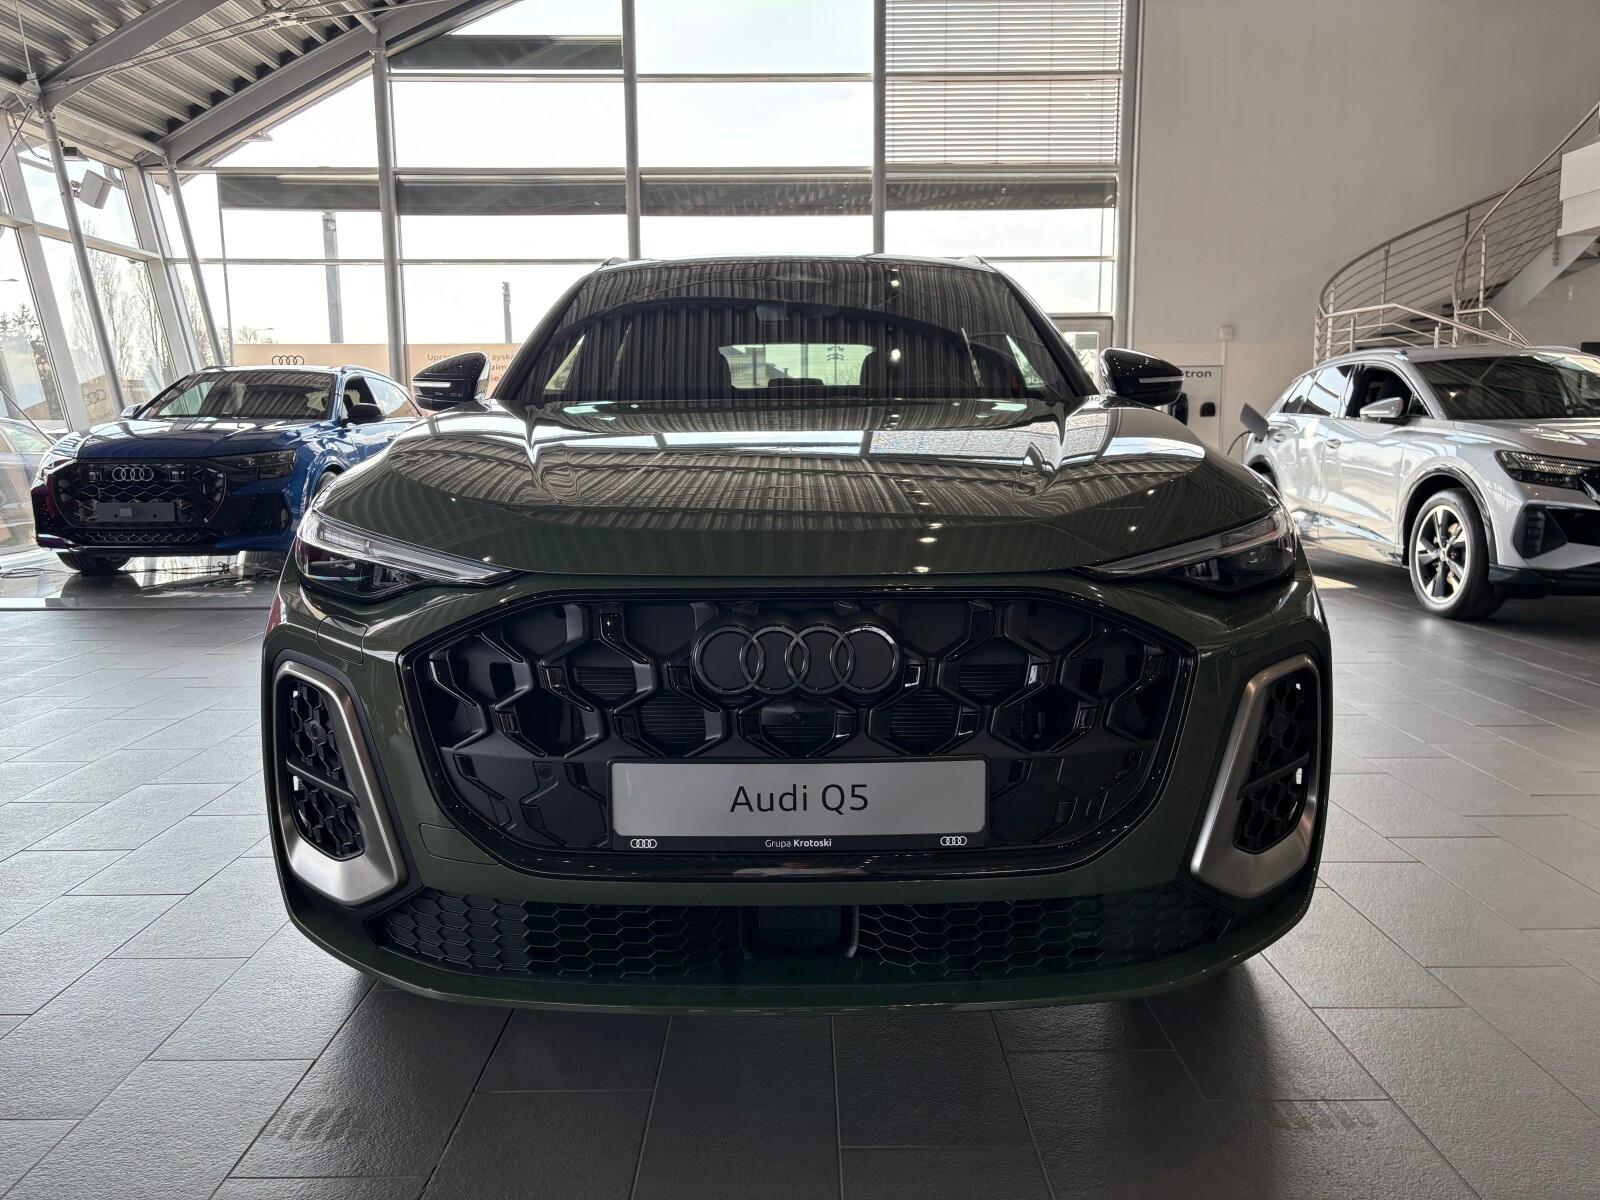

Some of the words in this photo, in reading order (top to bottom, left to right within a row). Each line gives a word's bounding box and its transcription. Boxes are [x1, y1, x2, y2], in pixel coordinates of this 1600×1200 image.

[1185, 370, 1212, 378] tron
[729, 783, 808, 813] Audi
[821, 783, 869, 815] Q5
[765, 839, 792, 849] Grupa
[793, 838, 832, 847] Krotoski
